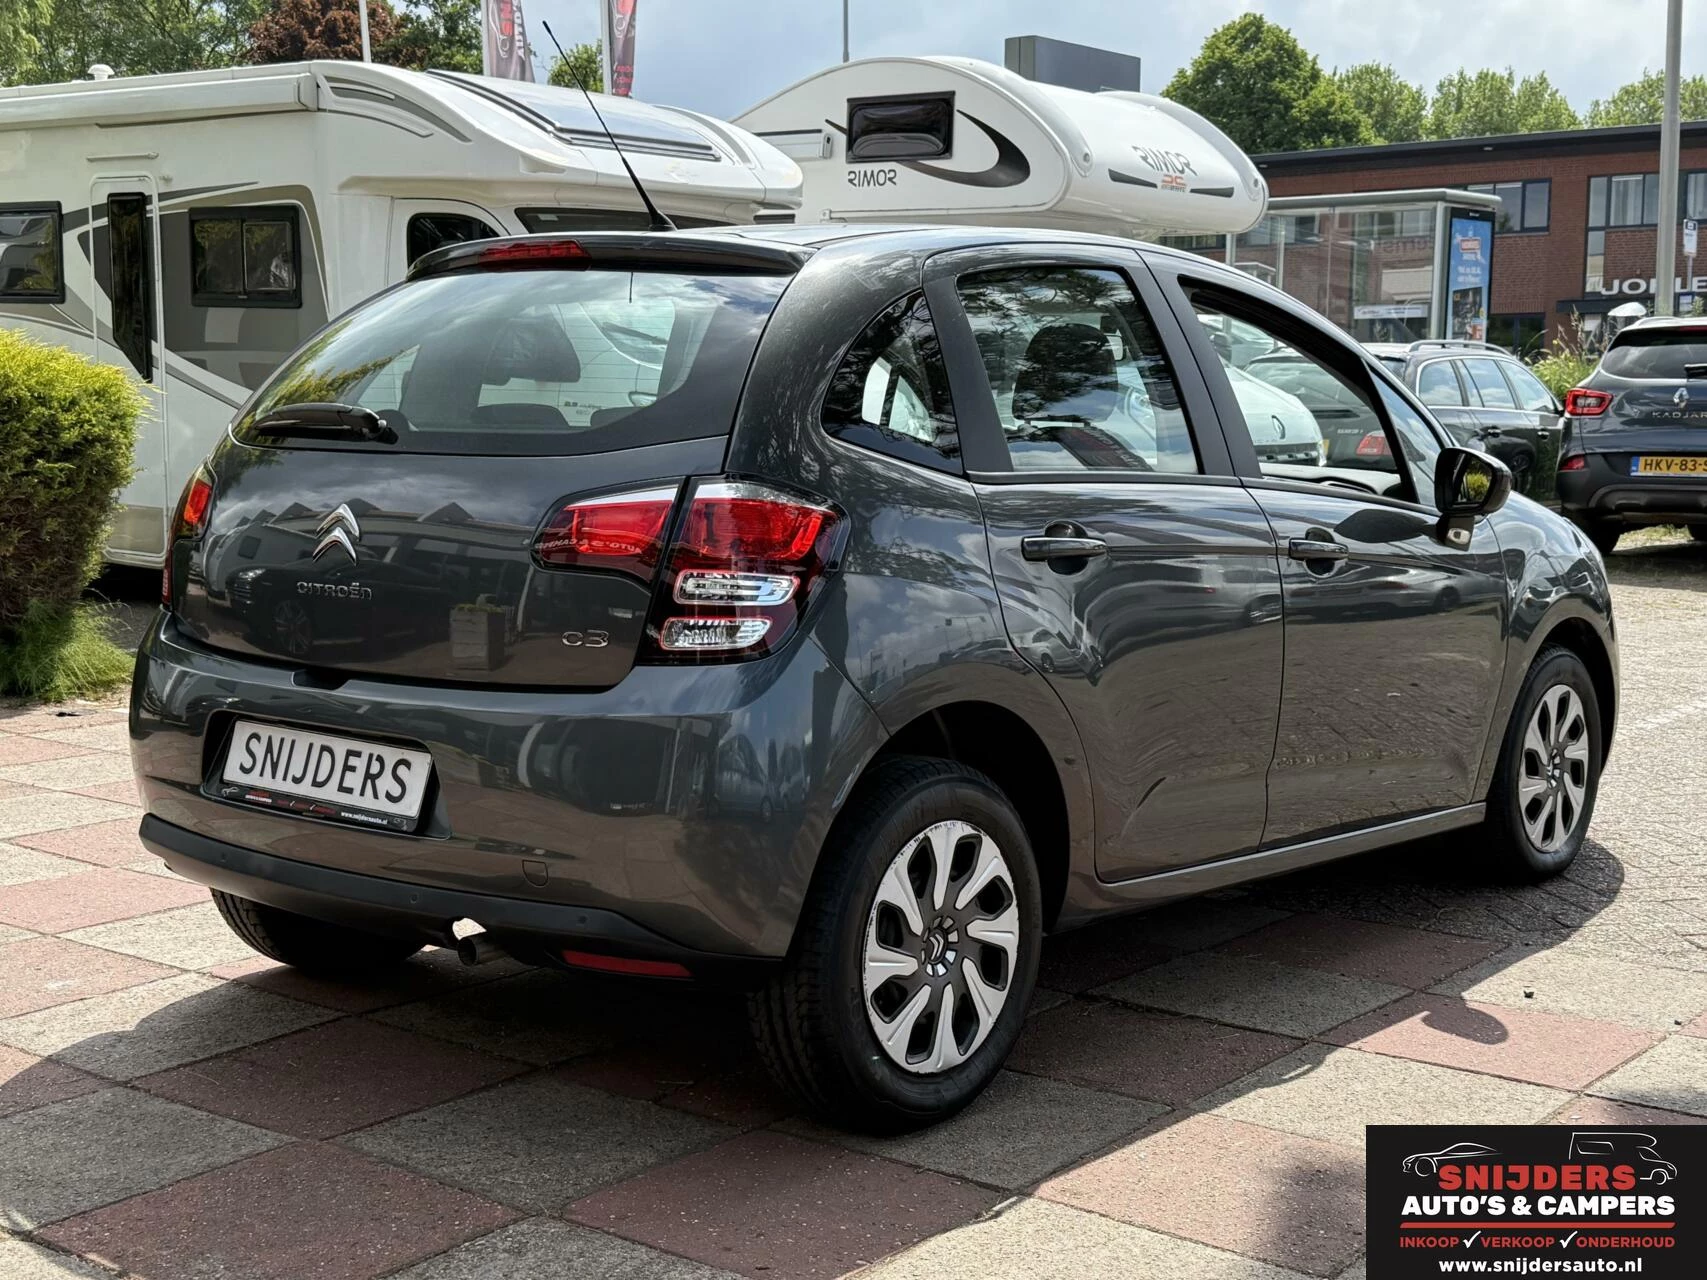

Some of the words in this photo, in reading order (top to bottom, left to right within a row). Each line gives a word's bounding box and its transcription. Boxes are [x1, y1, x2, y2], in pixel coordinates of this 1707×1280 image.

[1131, 145, 1198, 176] RIMOR
[847, 169, 897, 187] RIMOR
[562, 629, 609, 648] C3
[238, 731, 413, 805] SNIJDERS
